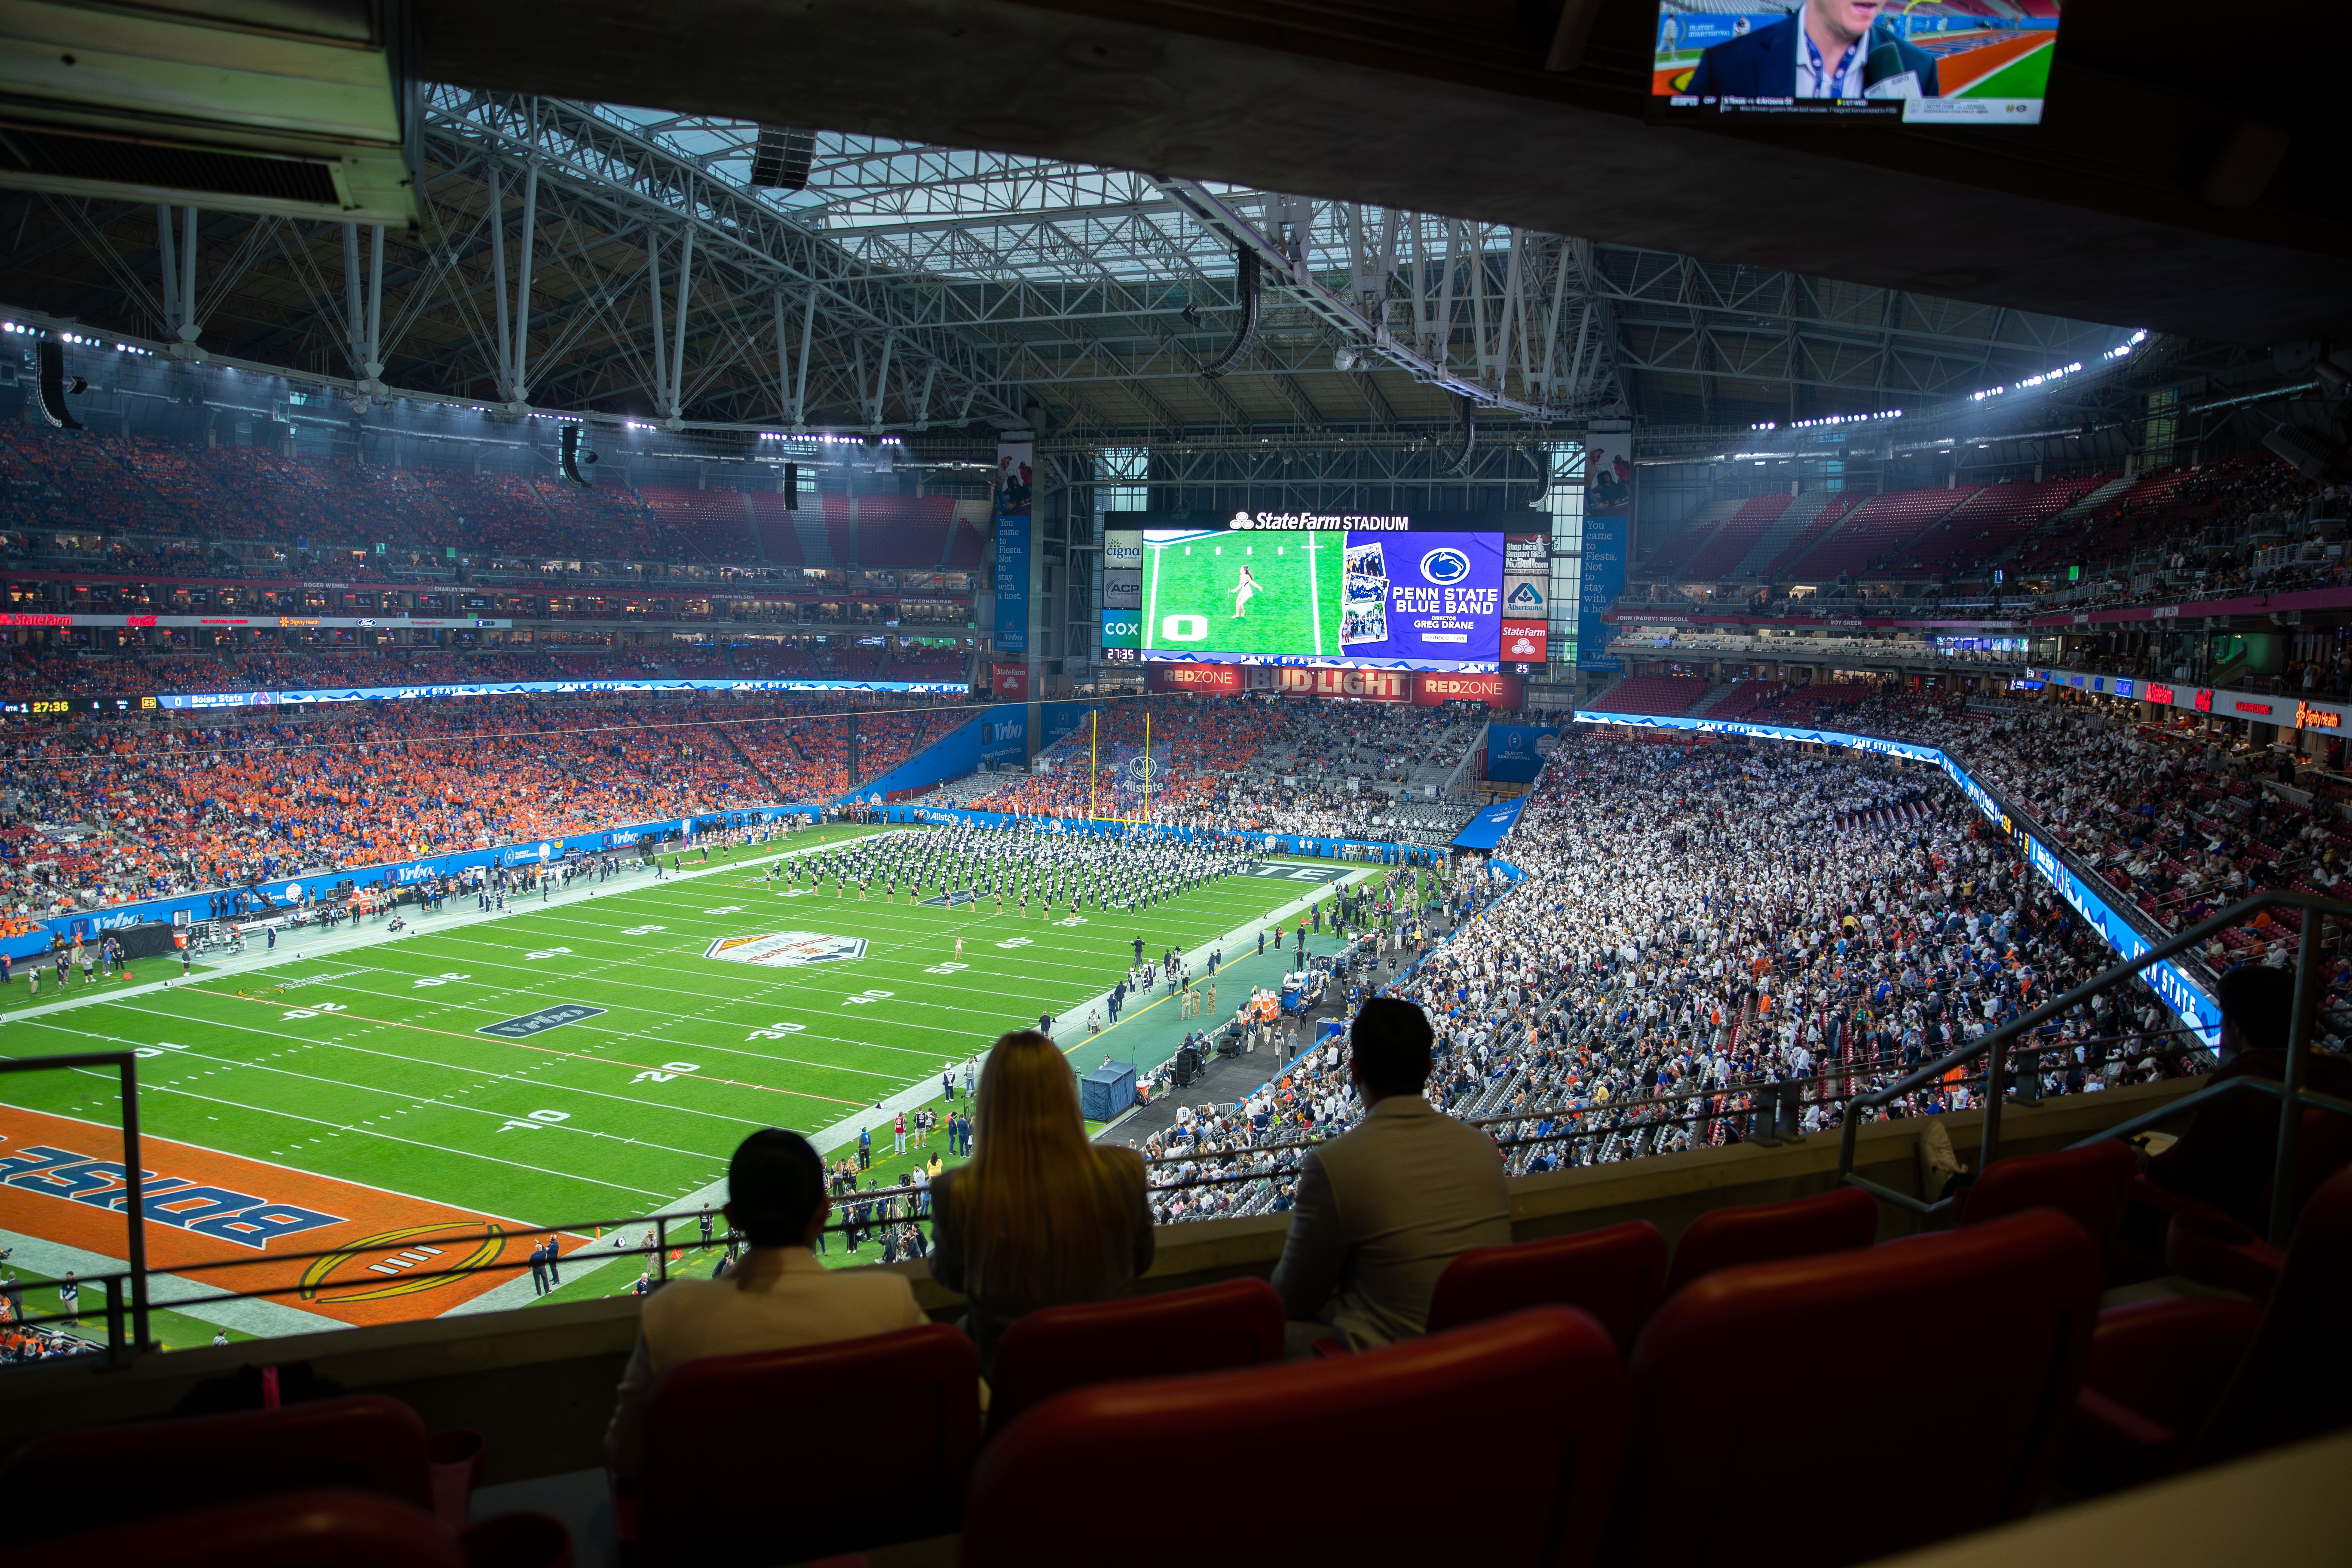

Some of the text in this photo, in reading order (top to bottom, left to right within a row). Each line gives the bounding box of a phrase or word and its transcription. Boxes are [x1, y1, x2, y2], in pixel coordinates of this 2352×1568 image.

[1343, 516, 1408, 530] STADIUM
[1587, 521, 1605, 530] You
[1106, 545, 1140, 559] cigna
[1586, 551, 1617, 560] Fiesta.
[1585, 562, 1602, 571] Not
[1111, 584, 1139, 593] ACP
[1393, 587, 1498, 602] PENN STATE
[1584, 584, 1605, 593] stay
[1583, 594, 1606, 603] with
[1396, 600, 1494, 615] BLUE BAND
[1105, 623, 1138, 636] COX
[1414, 620, 1474, 630] GREG DRANE
[1107, 649, 1134, 660] 27:35
[1517, 665, 1528, 673] 25
[1164, 670, 1233, 684] REDZONE
[1251, 668, 1407, 696] BUD LIGHT
[1426, 680, 1504, 695] REDZONE
[192, 695, 217, 704] Boise
[218, 694, 243, 703] State
[21, 702, 29, 713] 1
[33, 701, 69, 713] 27:36
[2305, 709, 2338, 728] Dignity Health
[994, 719, 1022, 741] Vrbo
[1121, 779, 1164, 793] Allstate
[930, 812, 959, 822] Allstate
[612, 830, 637, 845] Vrbo
[399, 864, 432, 881] Vrbo
[747, 936, 838, 962] Fiesta Bowl
[924, 962, 970, 975] 50
[275, 973, 331, 988] PLAYOFF
[284, 968, 375, 989] QUARTERFINAL
[852, 989, 894, 1005] 40
[2161, 969, 2196, 1013] STATE
[283, 1002, 348, 1019] 20
[1958, 1007, 1963, 1016] 2
[499, 1008, 586, 1034] Vrbo
[759, 1022, 807, 1040] 30
[640, 1061, 701, 1083] 20
[509, 1109, 571, 1131] 10
